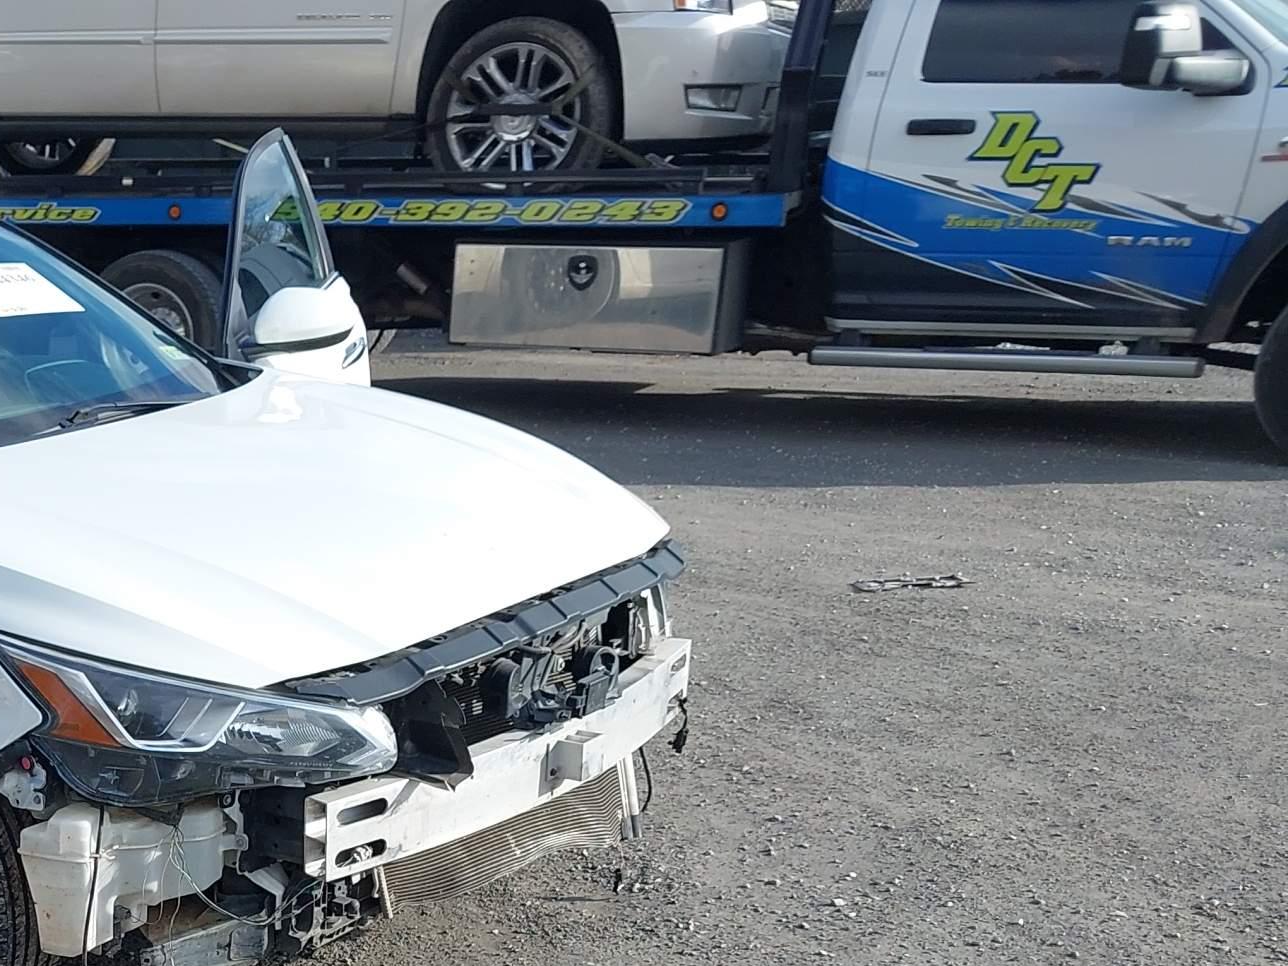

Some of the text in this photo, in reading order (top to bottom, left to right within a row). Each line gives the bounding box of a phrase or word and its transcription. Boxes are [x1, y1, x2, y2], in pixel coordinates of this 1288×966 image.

[966, 110, 1101, 213] DCT
[943, 213, 1003, 230] Towing
[1021, 213, 1097, 231] Recovery
[1106, 235, 1193, 248] RAM
